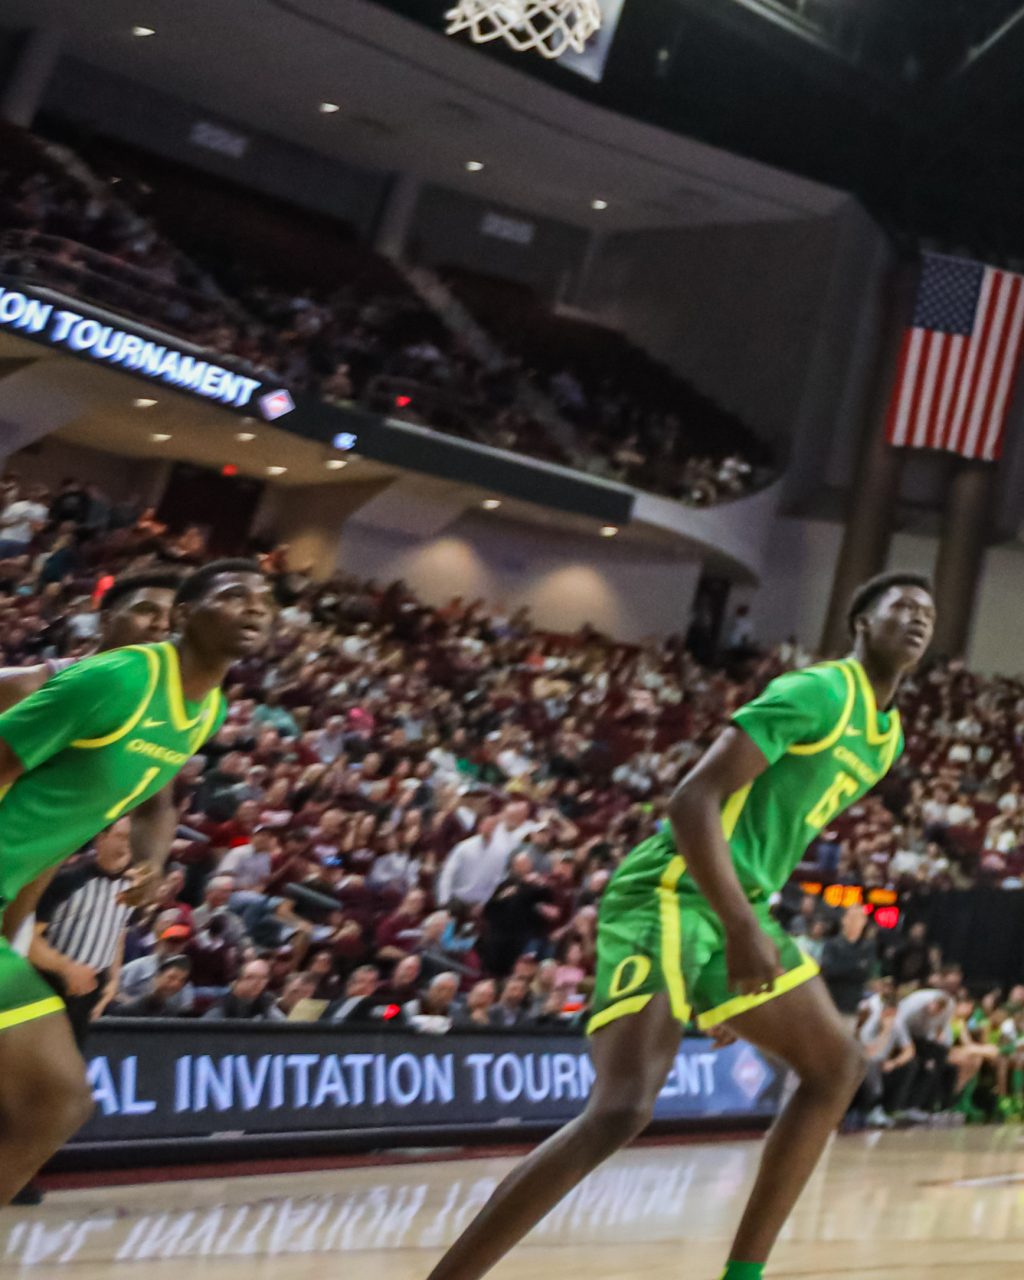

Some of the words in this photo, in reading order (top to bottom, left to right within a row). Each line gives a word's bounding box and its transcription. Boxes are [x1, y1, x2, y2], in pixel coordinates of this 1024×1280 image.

[51, 310, 262, 408] TOURNAMENT
[174, 1052, 455, 1114] INVITATION
[466, 1052, 718, 1104] TOURNENT
